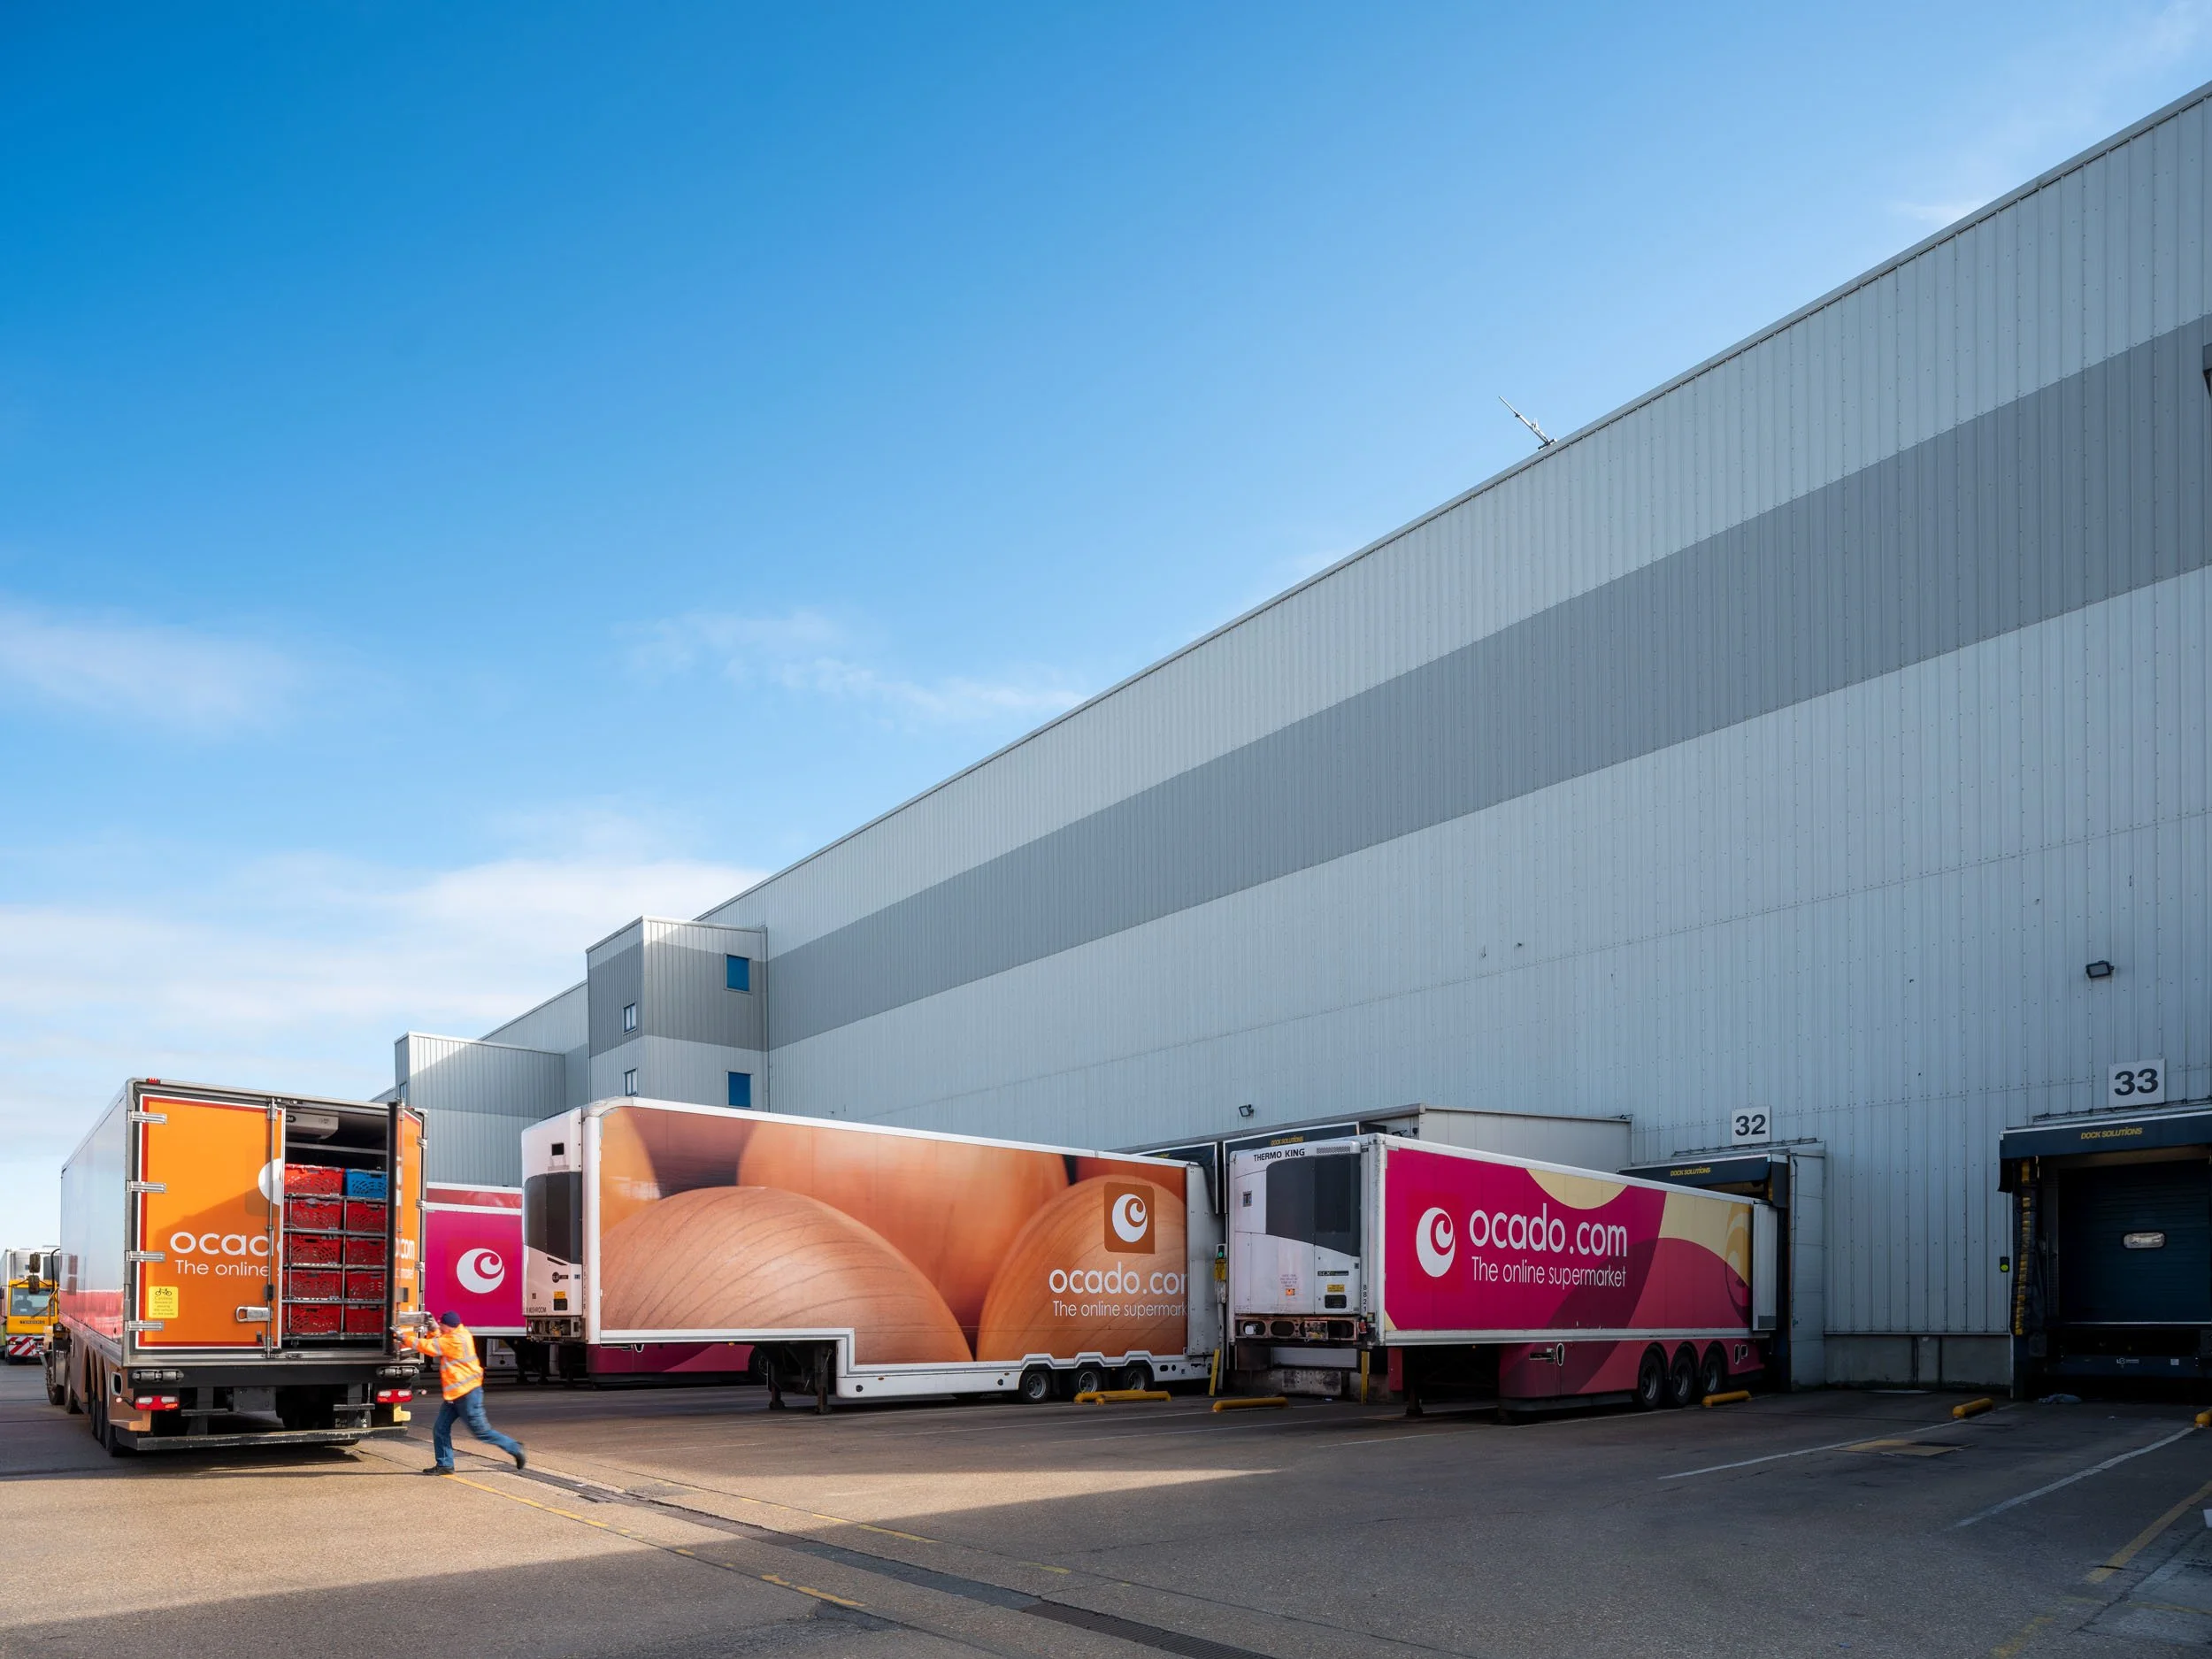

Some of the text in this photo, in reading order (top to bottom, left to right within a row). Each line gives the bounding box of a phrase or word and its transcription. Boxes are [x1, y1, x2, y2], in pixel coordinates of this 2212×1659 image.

[2114, 1068, 2159, 1096] 33
[1734, 1114, 1766, 1136] 32
[1253, 1148, 1305, 1162] THERMO KING
[1469, 1202, 1628, 1257] ocado.com
[174, 1259, 210, 1275] The
[214, 1261, 269, 1277] online
[1471, 1256, 1628, 1291] The online supermarket
[1053, 1301, 1077, 1317] The
[1080, 1301, 1120, 1317] online
